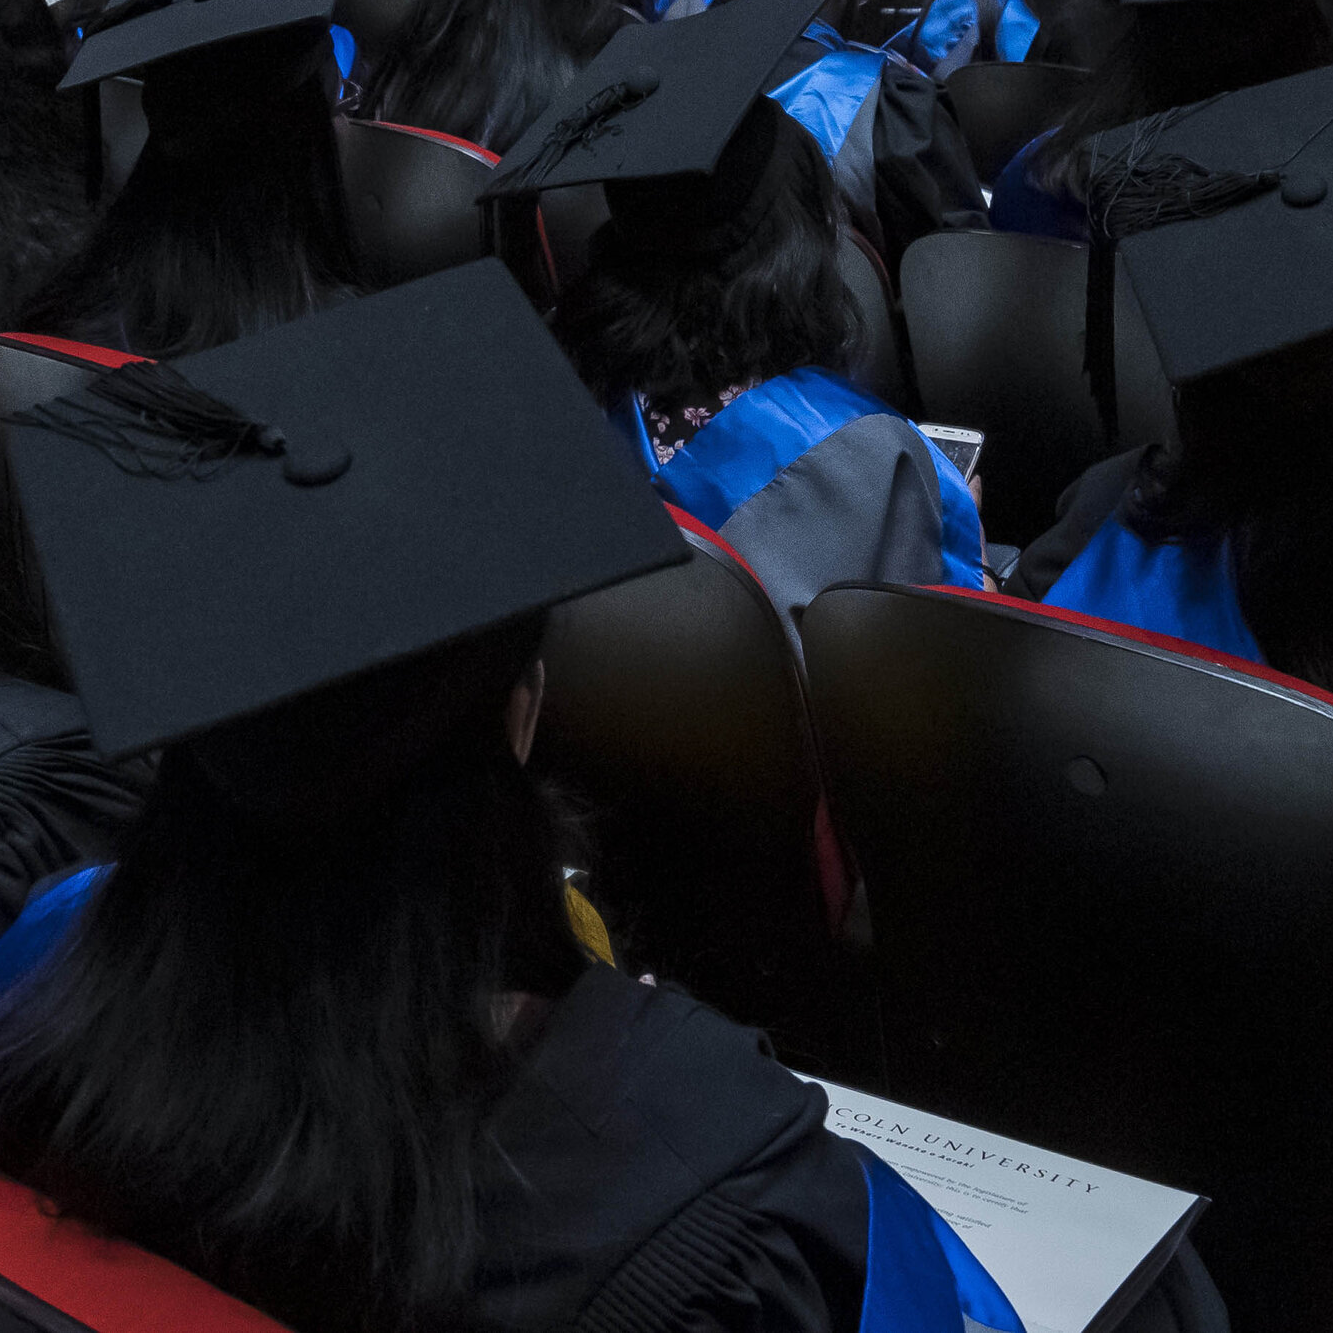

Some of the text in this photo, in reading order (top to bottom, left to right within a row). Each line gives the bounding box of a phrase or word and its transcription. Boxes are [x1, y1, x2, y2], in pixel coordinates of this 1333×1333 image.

[828, 1103, 1099, 1193] COLN UNIVERSITY
[849, 1126, 883, 1140] Whare
[937, 1153, 974, 1168] Aoraki
